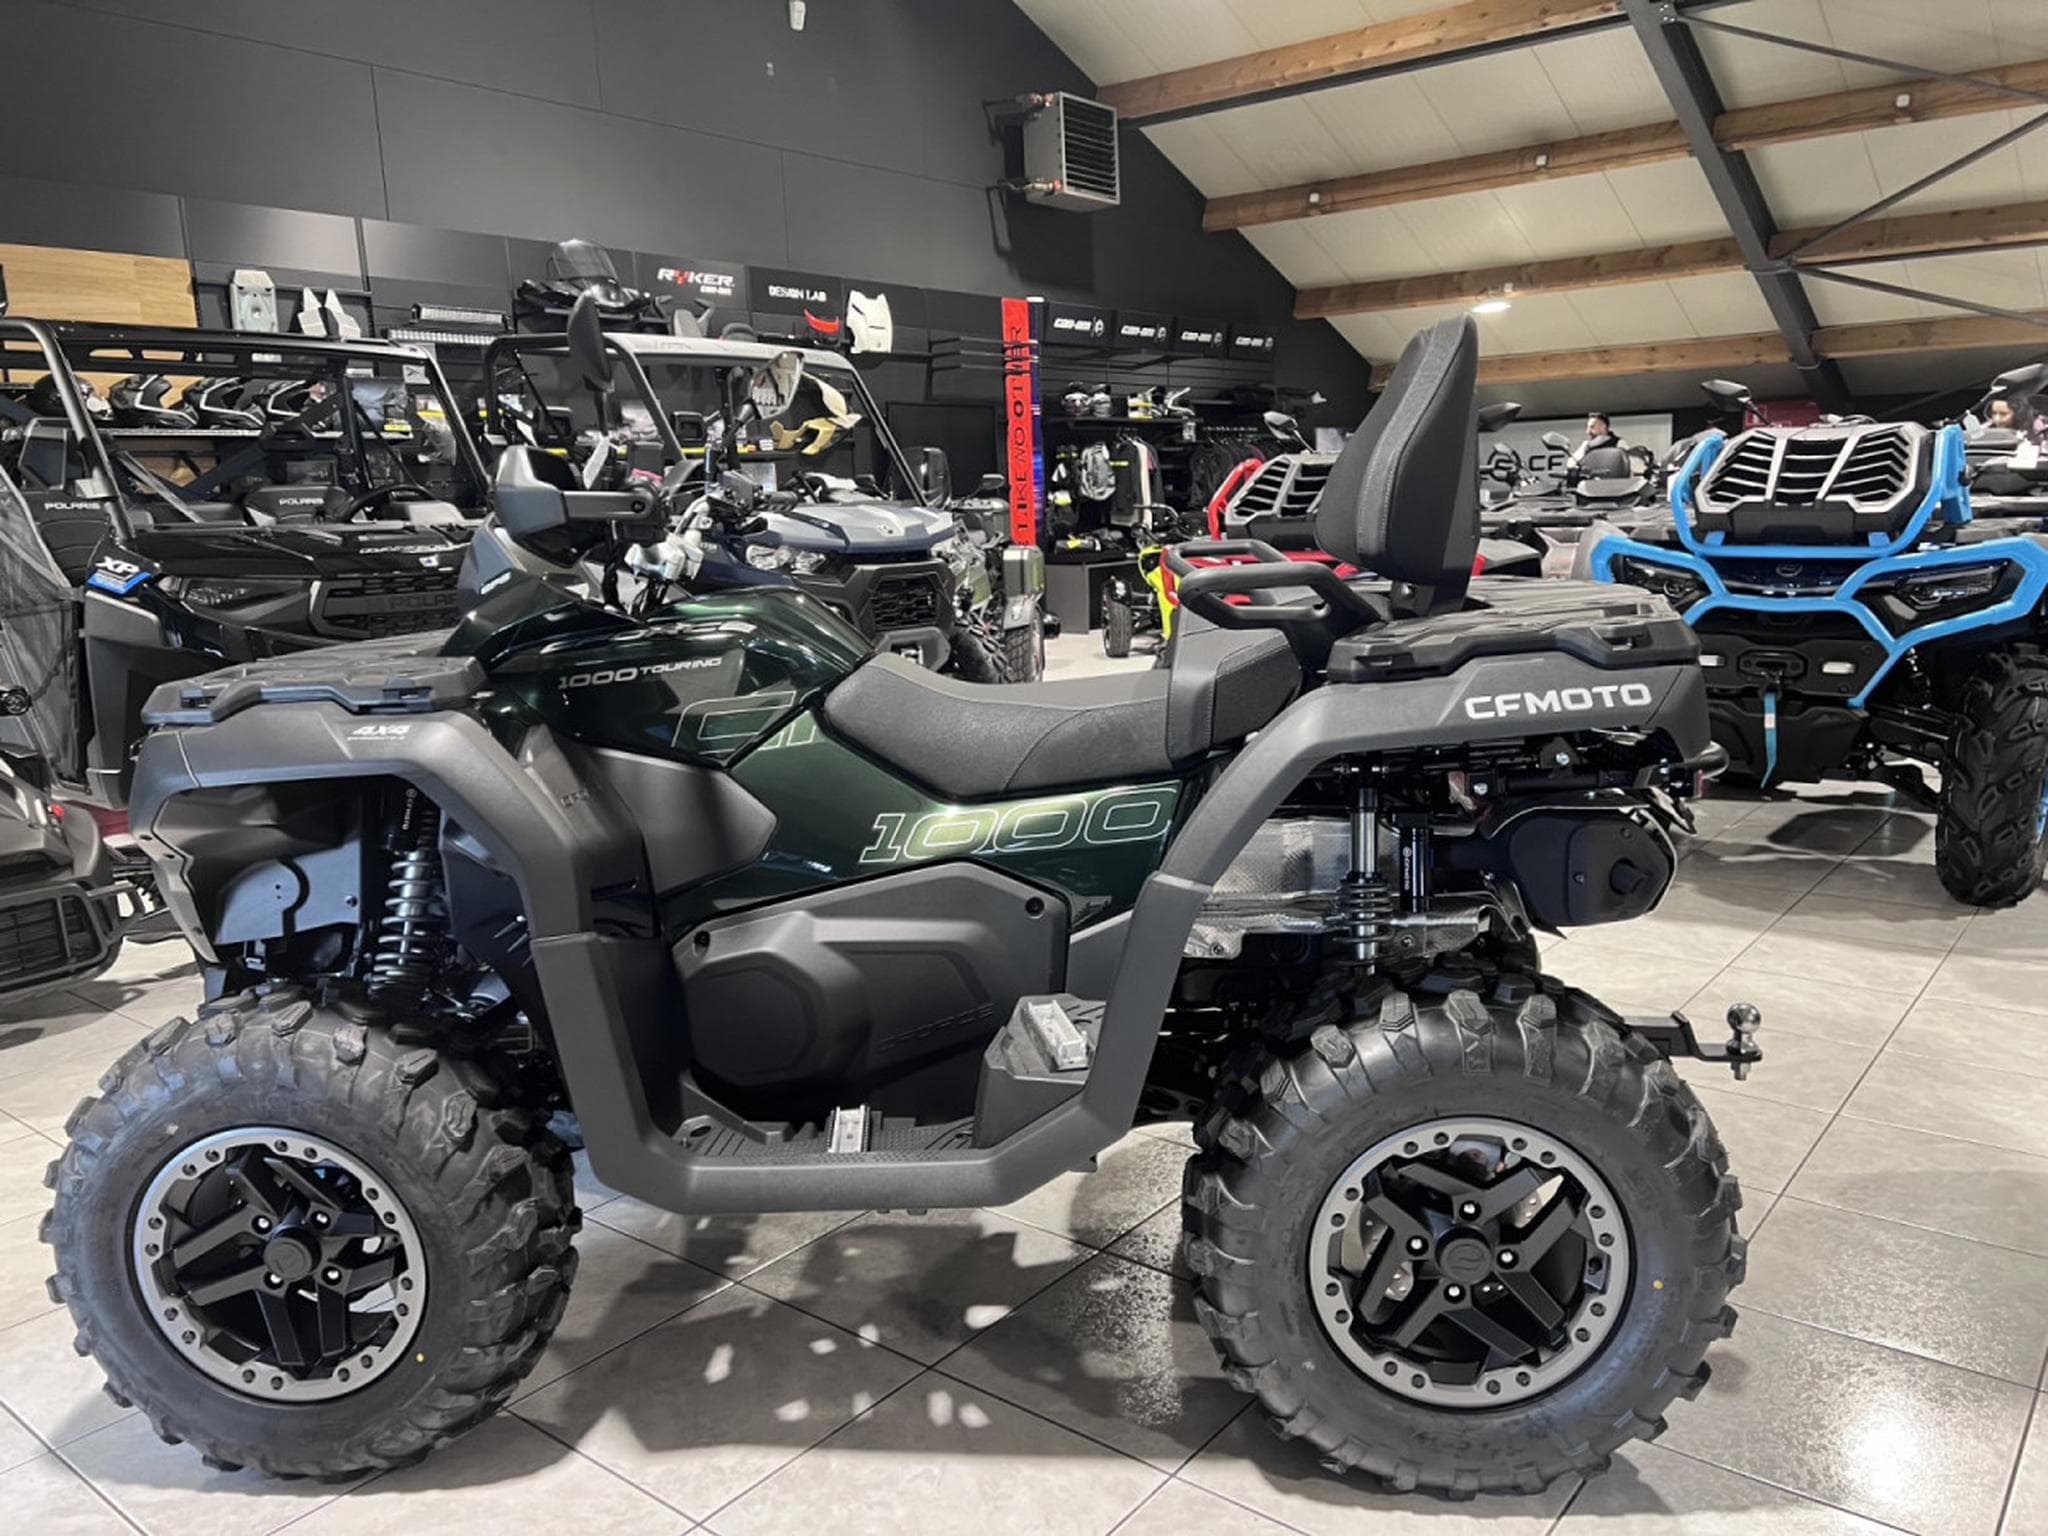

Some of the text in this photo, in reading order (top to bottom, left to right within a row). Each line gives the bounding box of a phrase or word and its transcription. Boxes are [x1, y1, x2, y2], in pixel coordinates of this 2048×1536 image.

[657, 267, 735, 285] RYKER
[768, 285, 827, 302] DESIGN LAB
[1014, 428, 1026, 463] NO
[44, 502, 101, 510] POLARIS
[279, 498, 325, 506] POLARIS
[95, 555, 140, 573] XP
[557, 656, 722, 690] 1000 TOURING
[1464, 682, 1652, 720] CFMOTO
[859, 787, 1178, 863] 1000
